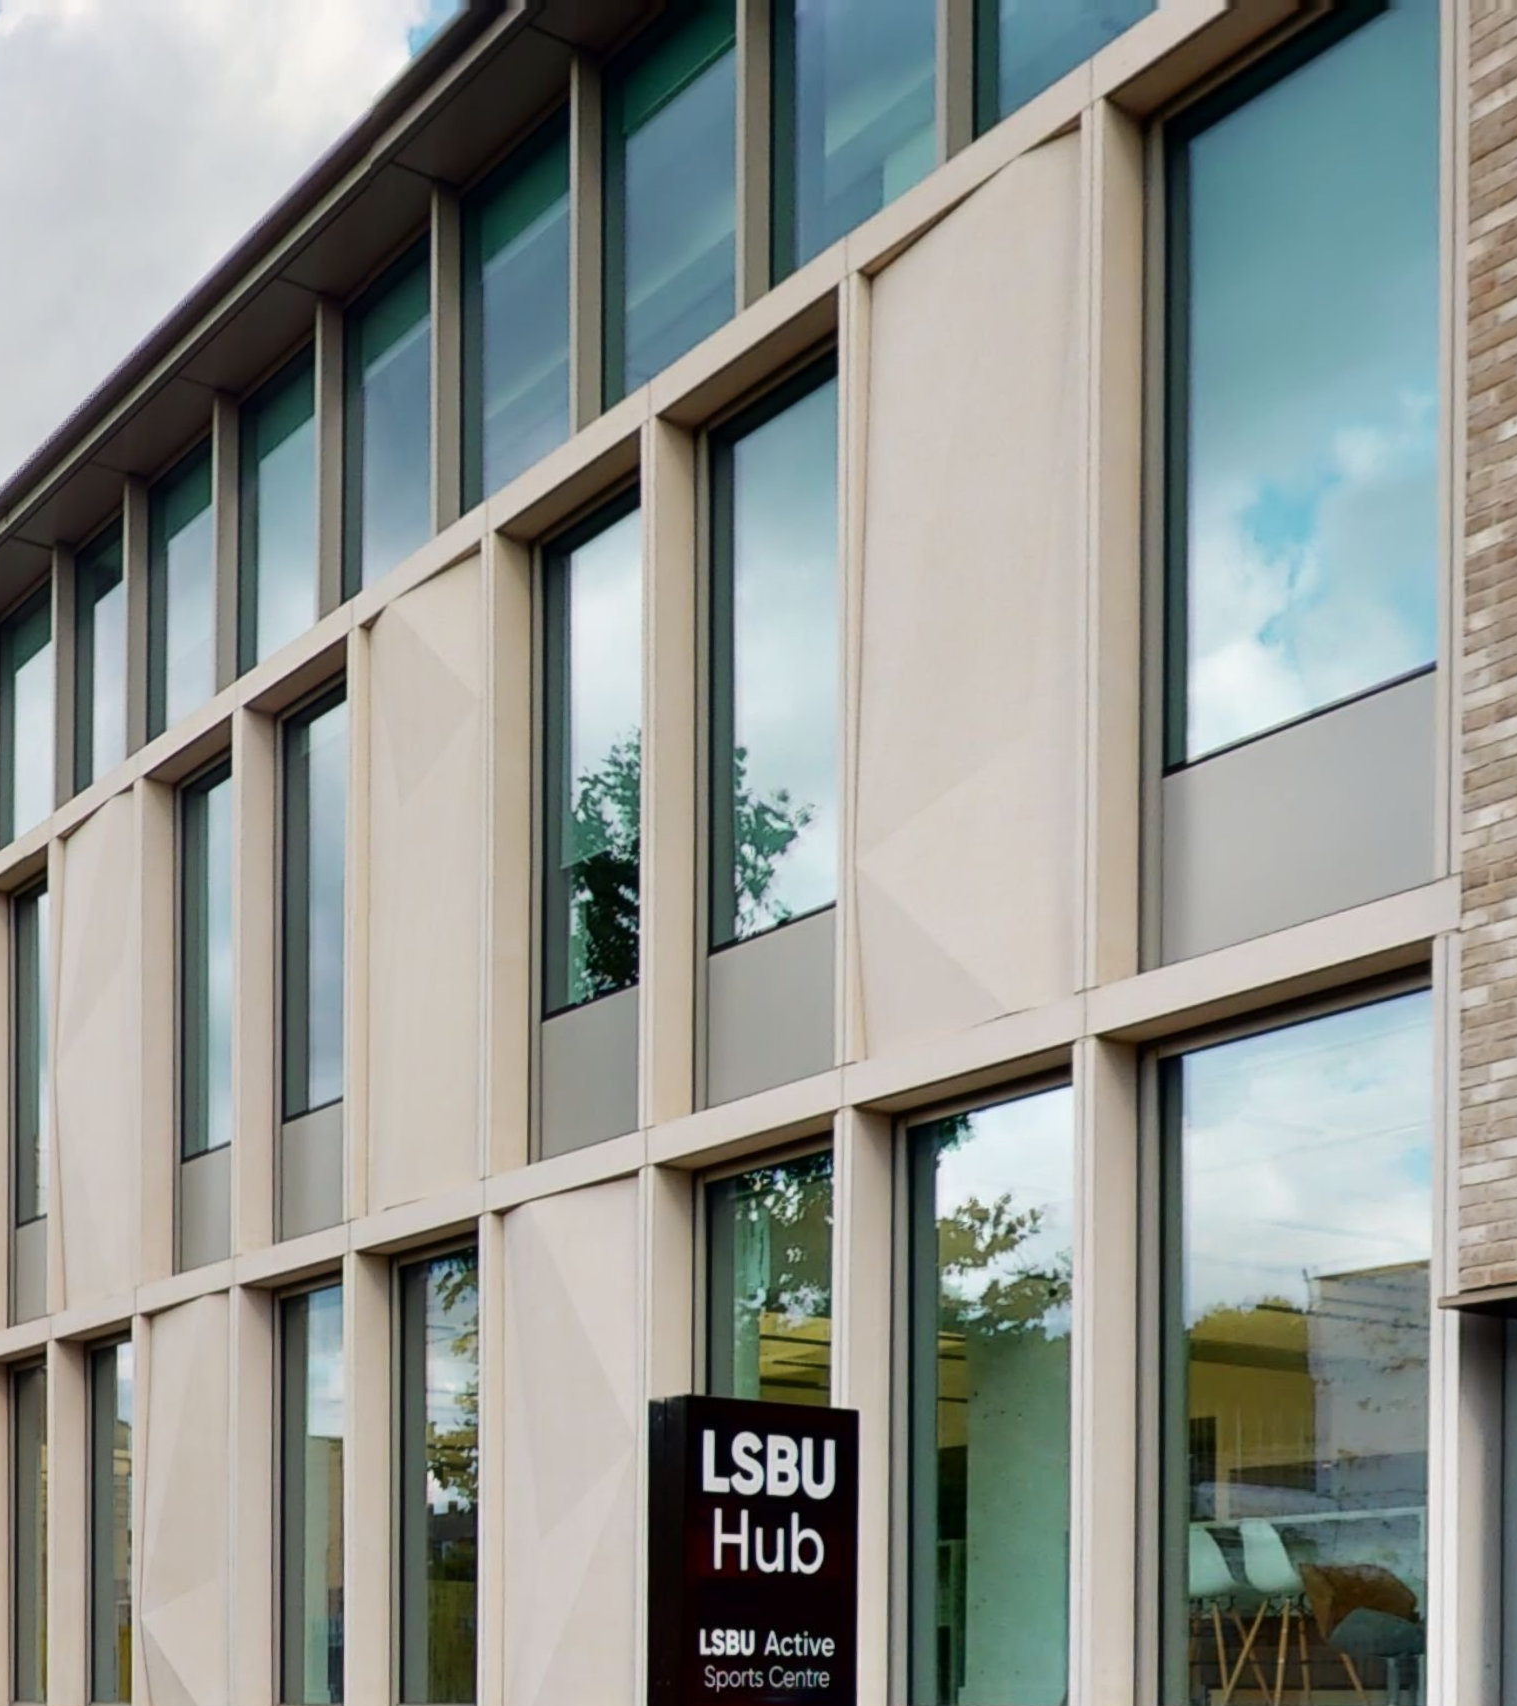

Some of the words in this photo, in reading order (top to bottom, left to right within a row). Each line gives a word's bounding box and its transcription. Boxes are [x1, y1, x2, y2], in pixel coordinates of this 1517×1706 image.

[703, 1429, 835, 1500] LSBU
[714, 1508, 824, 1574] Hub
[699, 1628, 755, 1656] LSBU
[764, 1630, 835, 1657] Active
[704, 1665, 763, 1692] Sports
[769, 1665, 830, 1687] Centre
